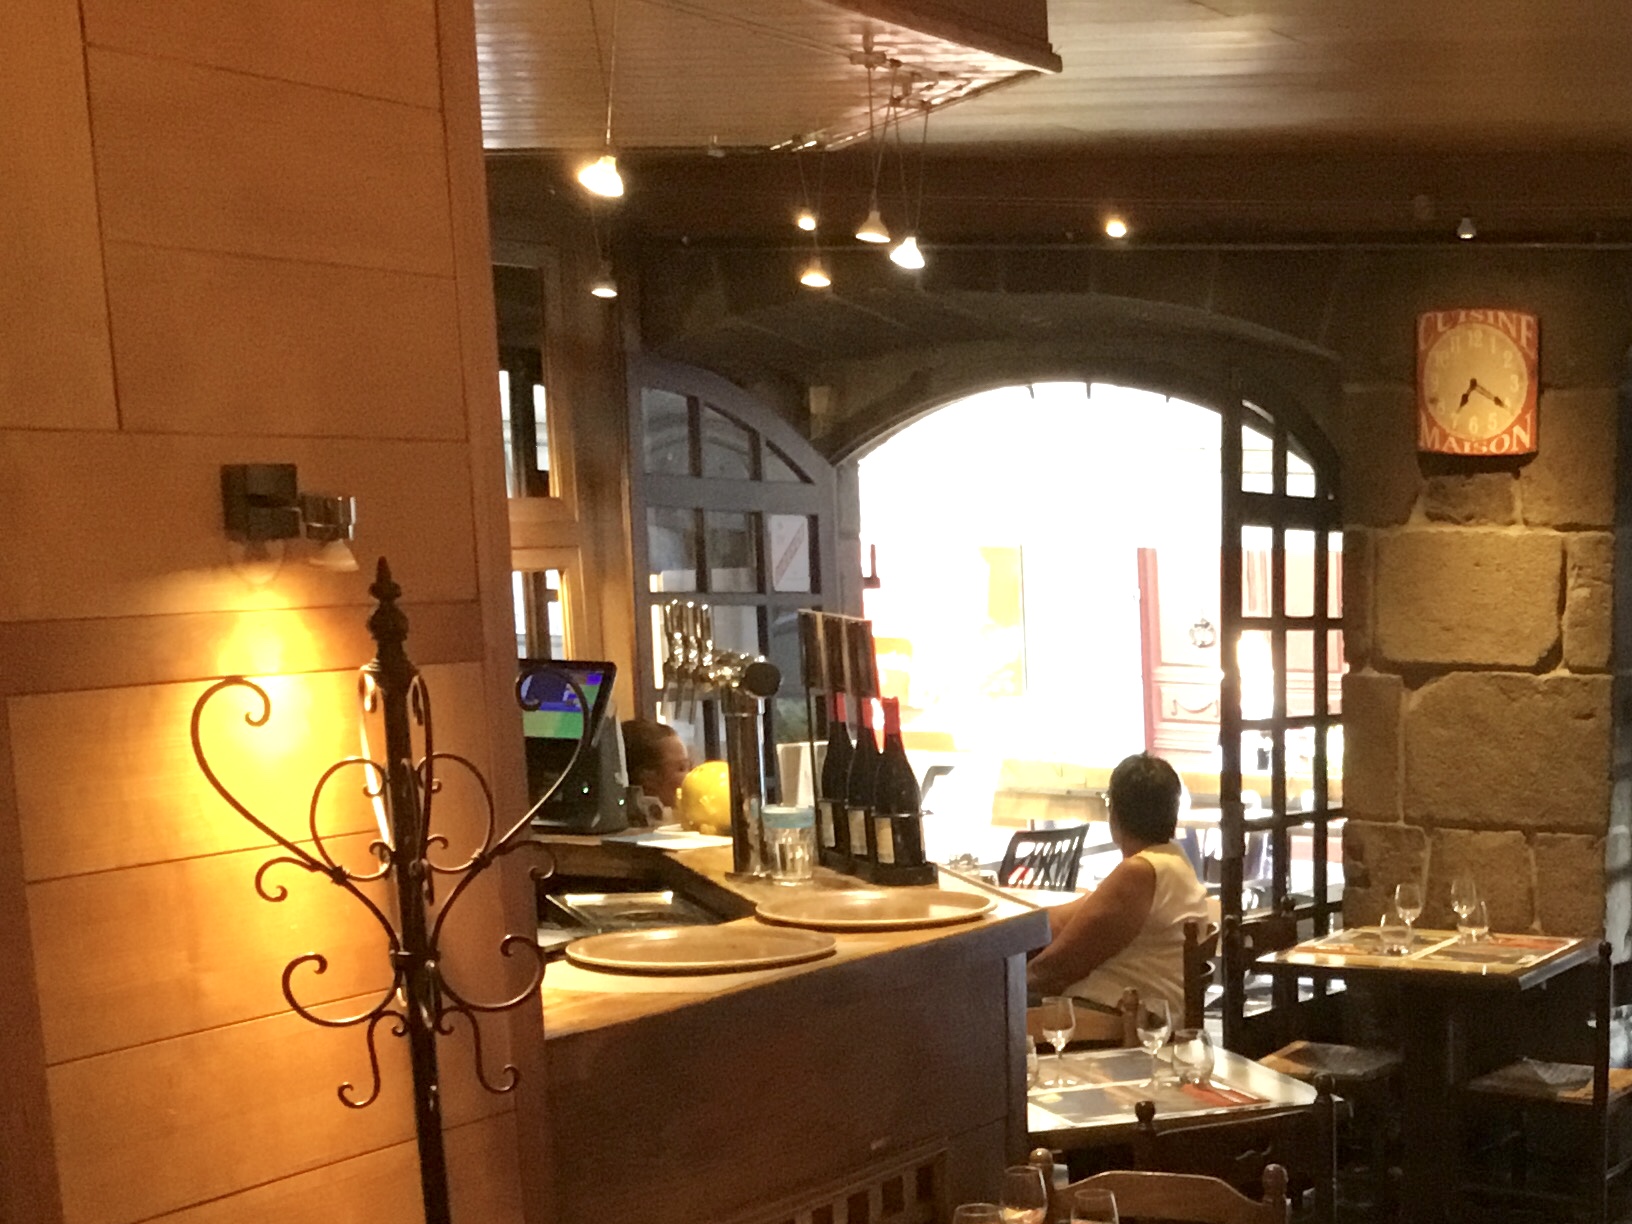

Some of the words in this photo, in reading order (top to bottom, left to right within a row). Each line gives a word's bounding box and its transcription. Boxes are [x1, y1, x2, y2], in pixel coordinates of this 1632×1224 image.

[1418, 310, 1534, 356] CUISINE
[1503, 350, 1513, 369] 2
[1510, 374, 1519, 393] 3
[1418, 409, 1532, 454] MAISON
